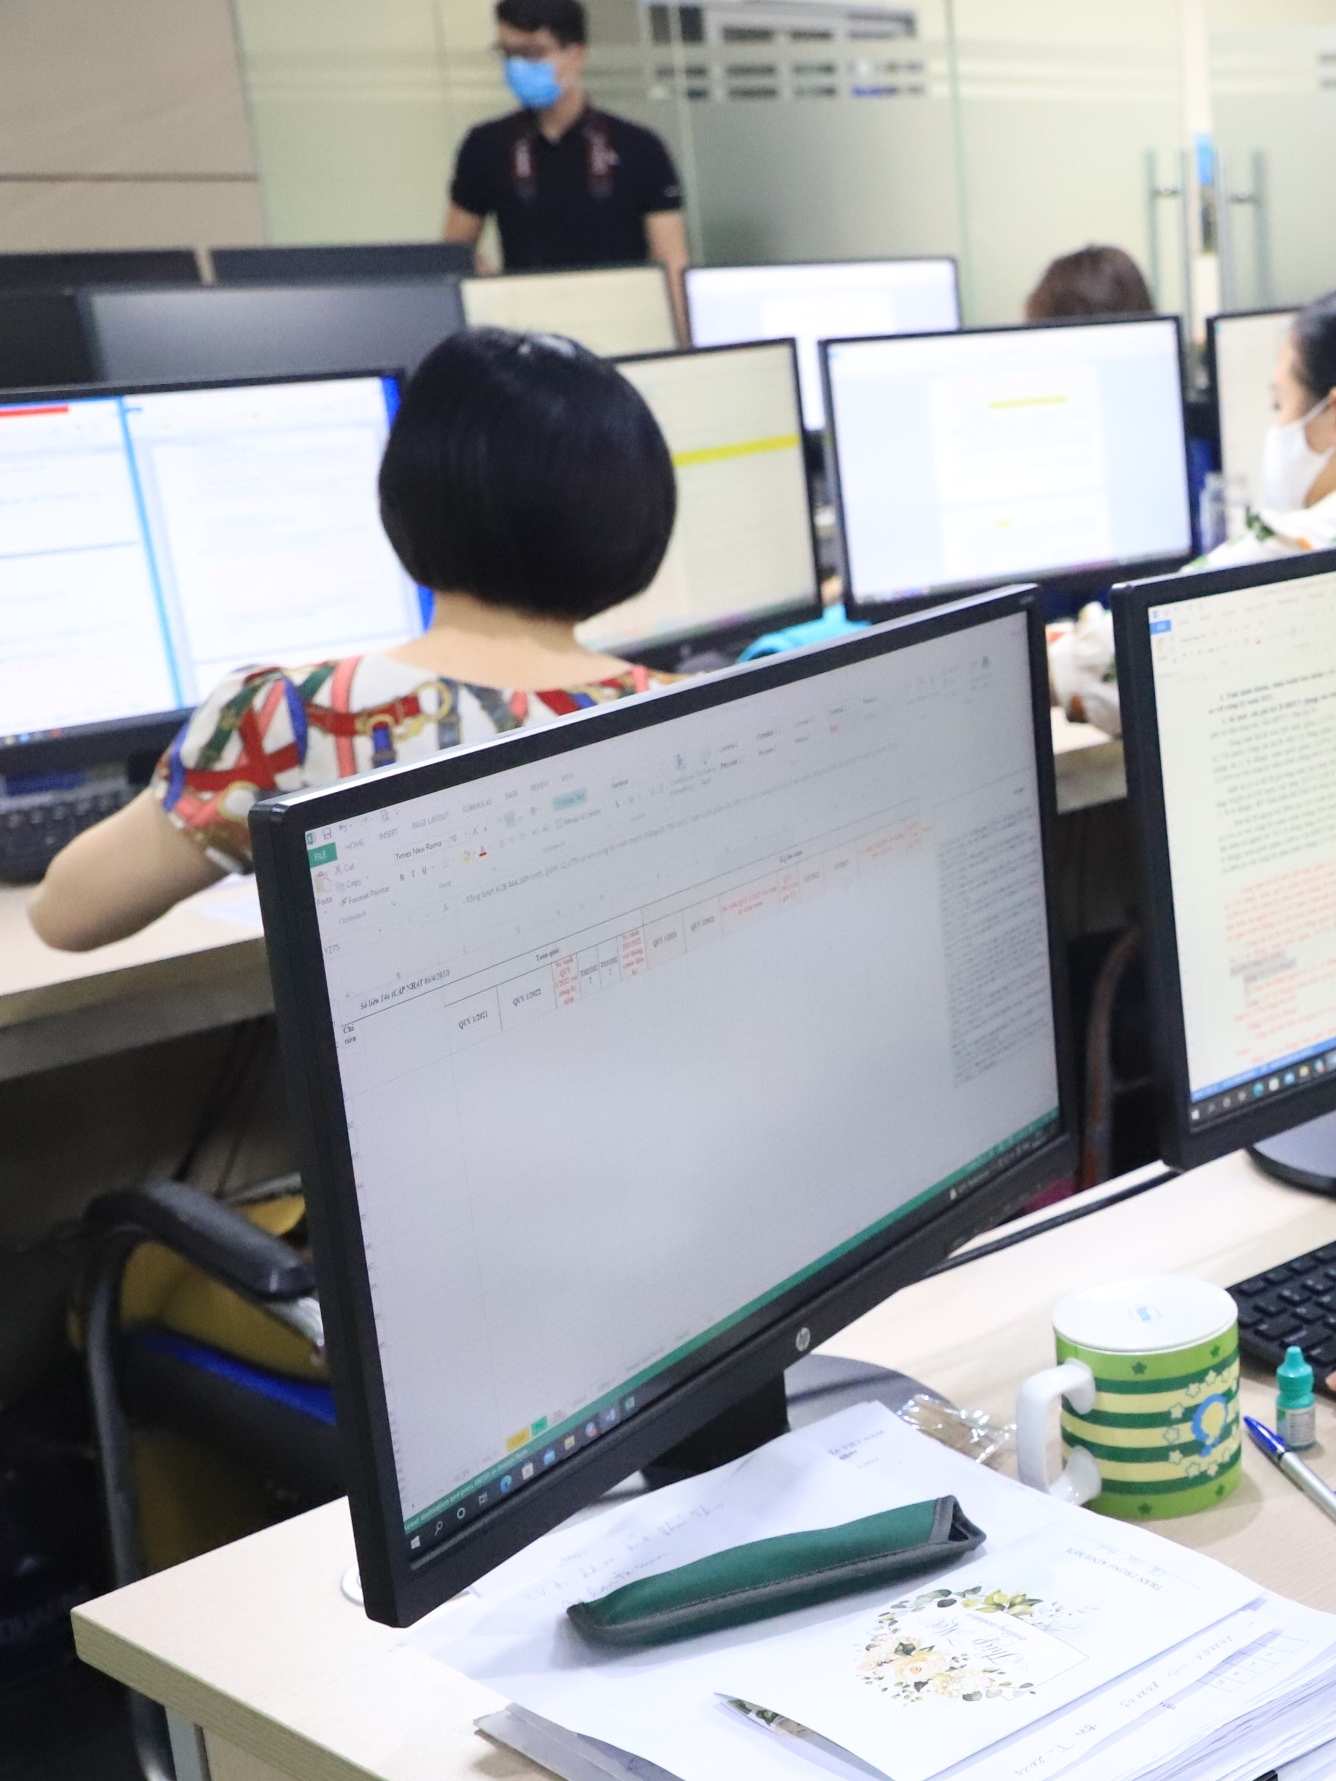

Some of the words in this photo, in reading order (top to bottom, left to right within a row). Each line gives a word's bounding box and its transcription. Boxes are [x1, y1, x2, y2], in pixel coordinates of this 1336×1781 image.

[313, 850, 327, 861] FILE
[345, 839, 365, 851] HOME
[379, 827, 399, 841] INSERT
[395, 849, 412, 861] Times
[412, 845, 426, 856] New
